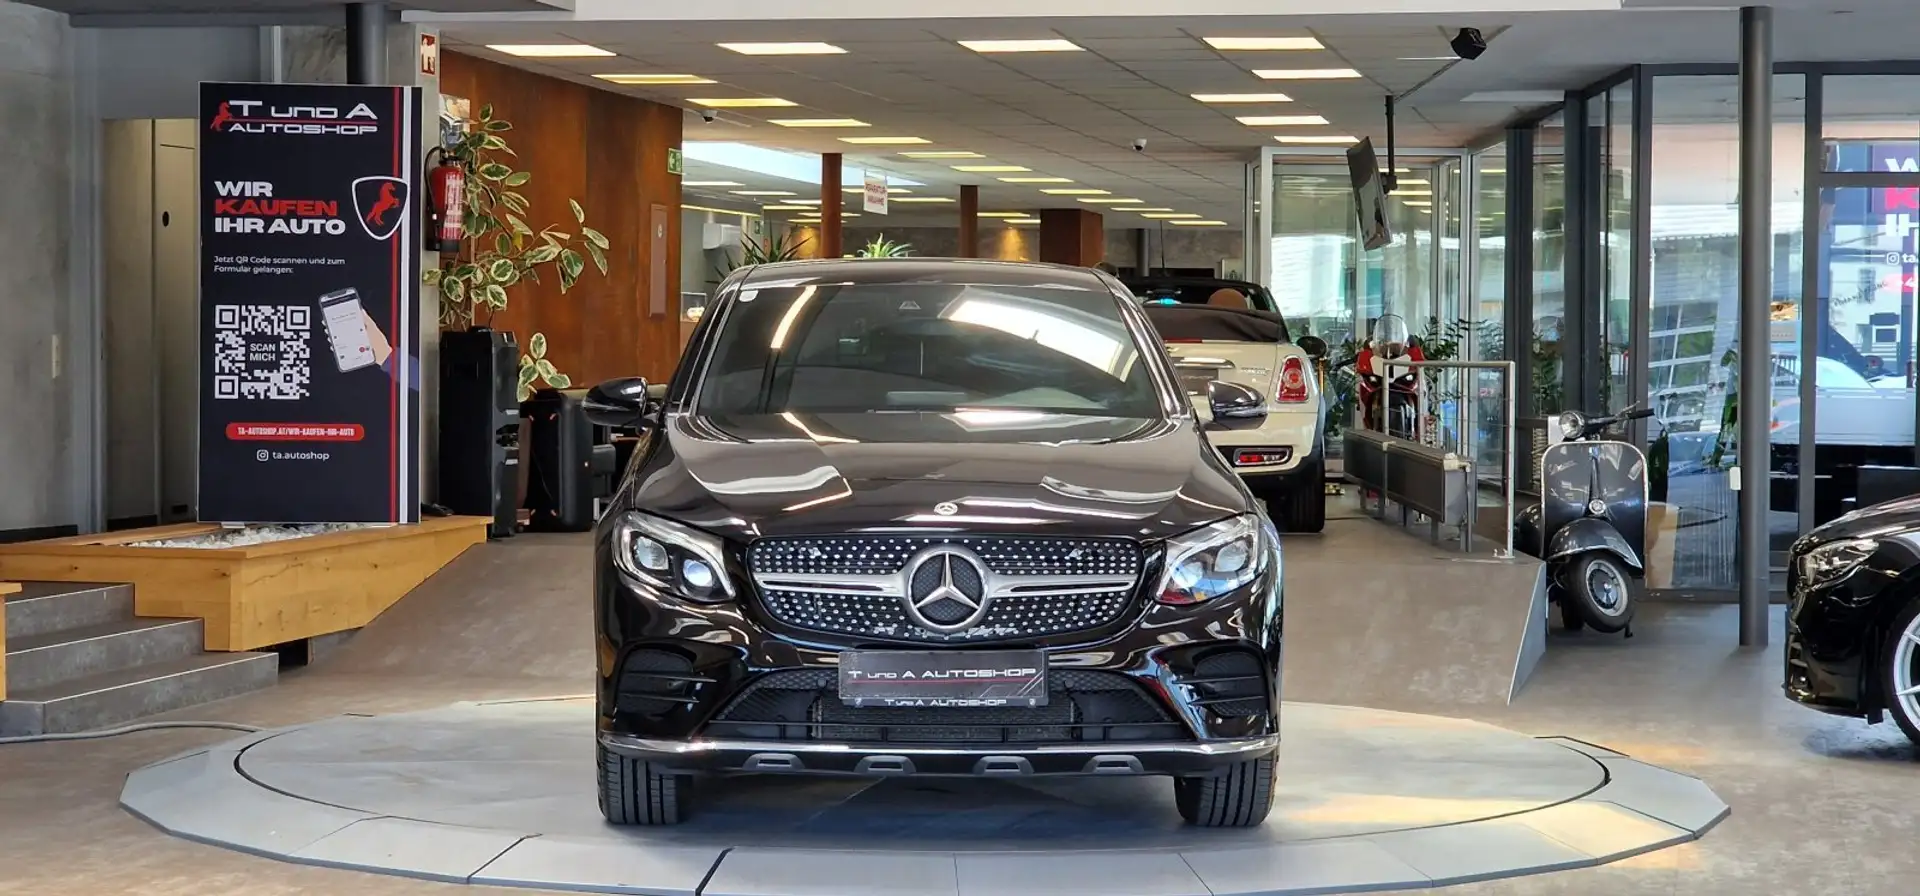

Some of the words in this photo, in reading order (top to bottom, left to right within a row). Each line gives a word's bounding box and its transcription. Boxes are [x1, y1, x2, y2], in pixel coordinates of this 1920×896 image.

[229, 100, 262, 116] T
[345, 103, 378, 119] A
[228, 123, 378, 135] AUTOSHOP
[214, 181, 273, 197] WIR
[215, 199, 338, 216] KAUFEN
[214, 217, 264, 233] IHR
[268, 218, 346, 235] AUTO
[214, 255, 234, 263] Jetzt
[235, 255, 249, 264] QR
[250, 256, 271, 264] Code
[214, 265, 251, 273] Formular
[253, 265, 293, 275] gelangen:
[250, 343, 276, 352] SCAN
[250, 352, 276, 361] MICH
[272, 451, 330, 462] ta.autoshop
[848, 670, 862, 679] T
[902, 670, 916, 679] A
[921, 668, 1036, 678] AUTOSHOP
